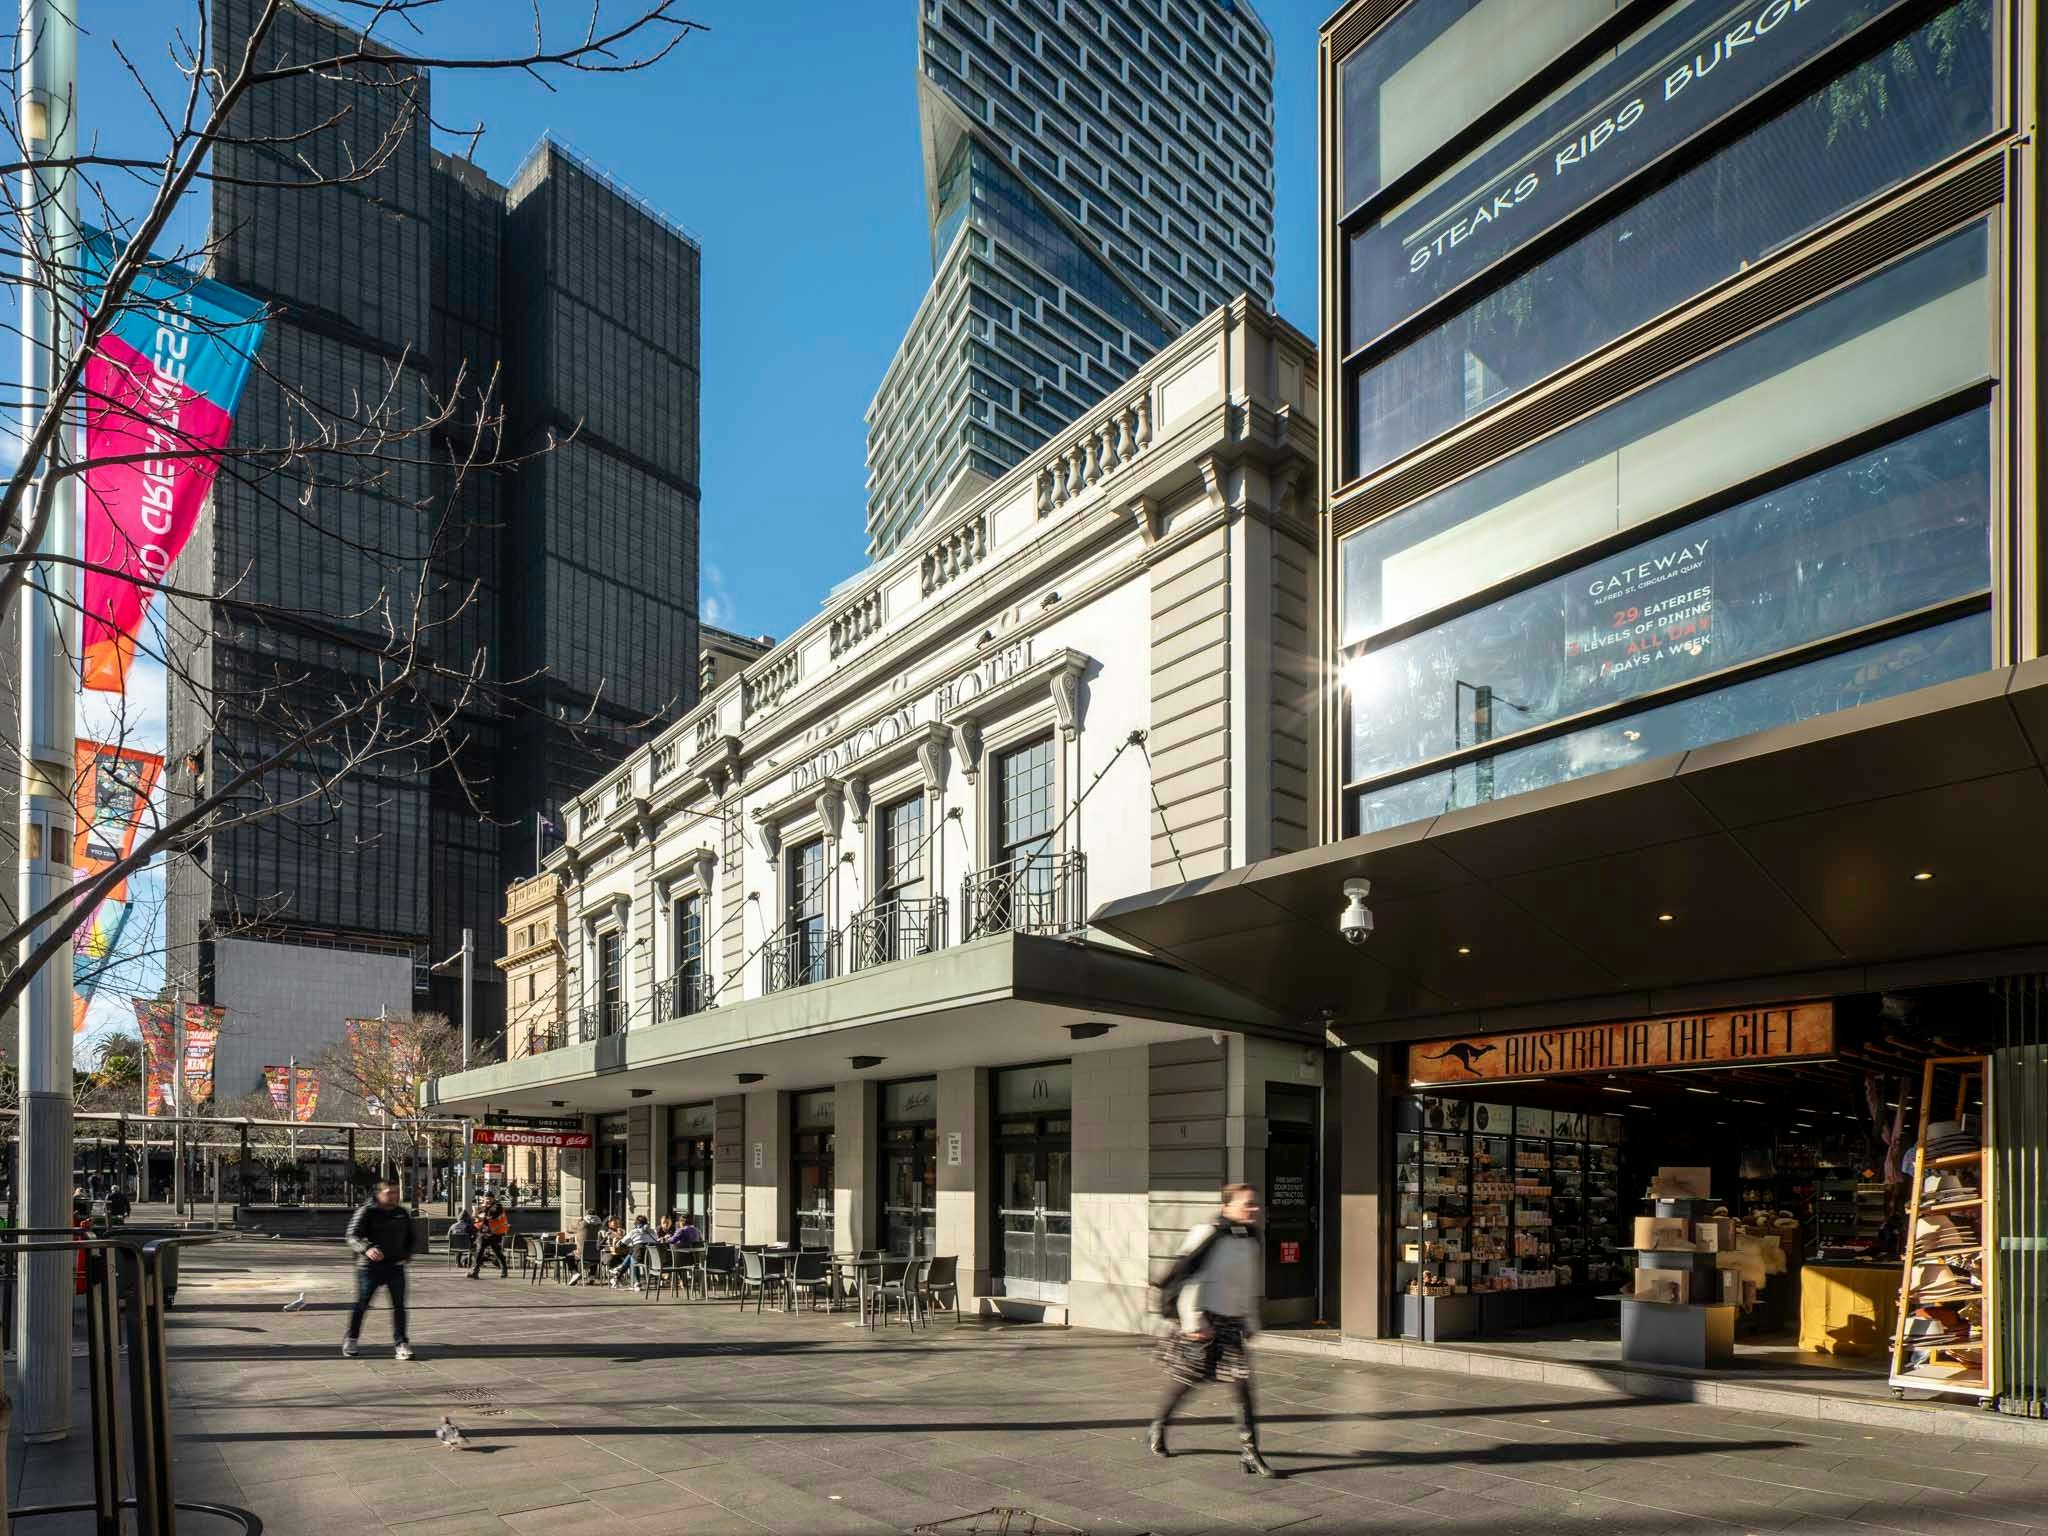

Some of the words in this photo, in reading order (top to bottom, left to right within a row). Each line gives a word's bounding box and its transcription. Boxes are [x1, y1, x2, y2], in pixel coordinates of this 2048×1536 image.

[1409, 172, 1540, 273] STEAKS
[1555, 98, 1645, 176] RIBS
[1588, 539, 1709, 596] GATEWAY
[1637, 570, 1679, 590] CIRCULAR
[1680, 561, 1704, 574] QUAY
[1583, 628, 1632, 653] LEVELS
[1635, 620, 1654, 635] OF
[1658, 601, 1712, 628] DINING
[1613, 607, 1640, 627] 29
[1644, 586, 1711, 617] EATERIES
[1613, 654, 1650, 673] DAYS
[1655, 650, 1664, 661] A
[1627, 634, 1663, 655] ALL
[1504, 1023, 1649, 1075] AUSTRALIA
[1662, 1016, 1715, 1062] THE
[1729, 1009, 1800, 1057] GIFT
[492, 1133, 562, 1145] McDonald's
